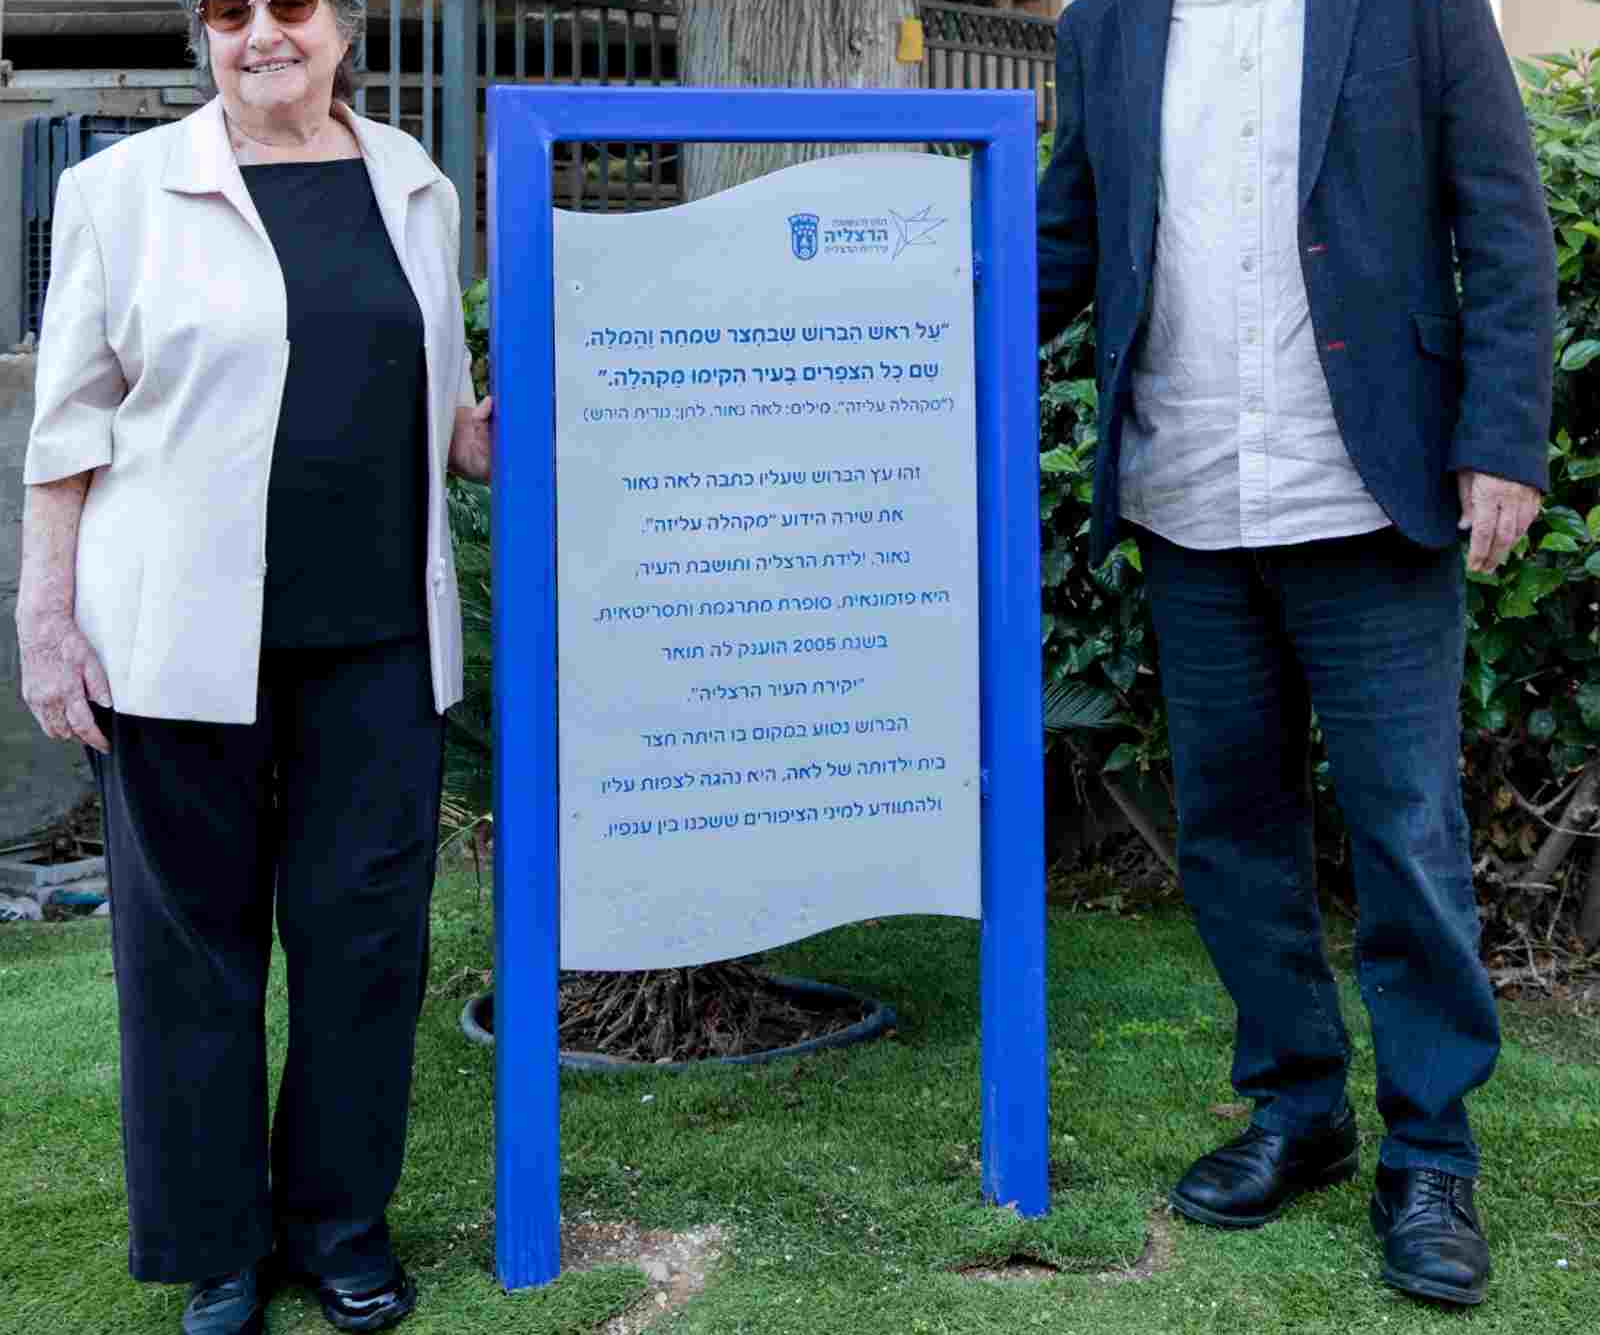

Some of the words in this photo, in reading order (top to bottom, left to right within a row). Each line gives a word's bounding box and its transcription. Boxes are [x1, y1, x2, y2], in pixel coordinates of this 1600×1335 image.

[824, 227, 888, 243] הרצליה
[751, 400, 782, 416] לאה
[664, 471, 701, 489] לאה
[706, 472, 754, 488] כתבה
[759, 469, 806, 486] שעליו
[812, 469, 865, 484] הברוש
[870, 468, 892, 484] עץ
[898, 466, 921, 481] זהו
[622, 475, 658, 491] נאור
[781, 511, 826, 527] הידוע
[832, 510, 873, 525] שירה
[878, 508, 904, 523] את
[685, 558, 751, 574] ותושבת
[756, 554, 817, 571] הרצליה
[822, 549, 866, 568] ילידת
[778, 596, 832, 612] סופרת
[920, 589, 951, 604] היא
[699, 600, 773, 616] מתרגמת
[710, 640, 733, 657] לה
[738, 640, 787, 658] הוענק
[793, 638, 836, 653] 2005
[841, 633, 888, 649] בשנת
[661, 645, 705, 661] תואר
[767, 681, 807, 696] העיר
[752, 725, 807, 742] במקום
[813, 720, 850, 737] נטוע
[855, 717, 908, 734] הברוש
[641, 733, 676, 748] חצר
[682, 729, 725, 745] היתה
[731, 728, 747, 742] בו
[827, 761, 852, 777] של
[857, 757, 912, 776] ילדותה
[918, 755, 945, 771] בית
[640, 772, 695, 791] לצפות
[700, 770, 742, 786] נהגה
[747, 767, 777, 783] היא
[601, 776, 635, 794] עליו
[823, 801, 863, 820] למיני
[869, 796, 943, 817] ולהתוודע
[684, 814, 739, 830] ששכנו
[744, 807, 819, 825] הציפורים
[657, 819, 680, 835] בין
